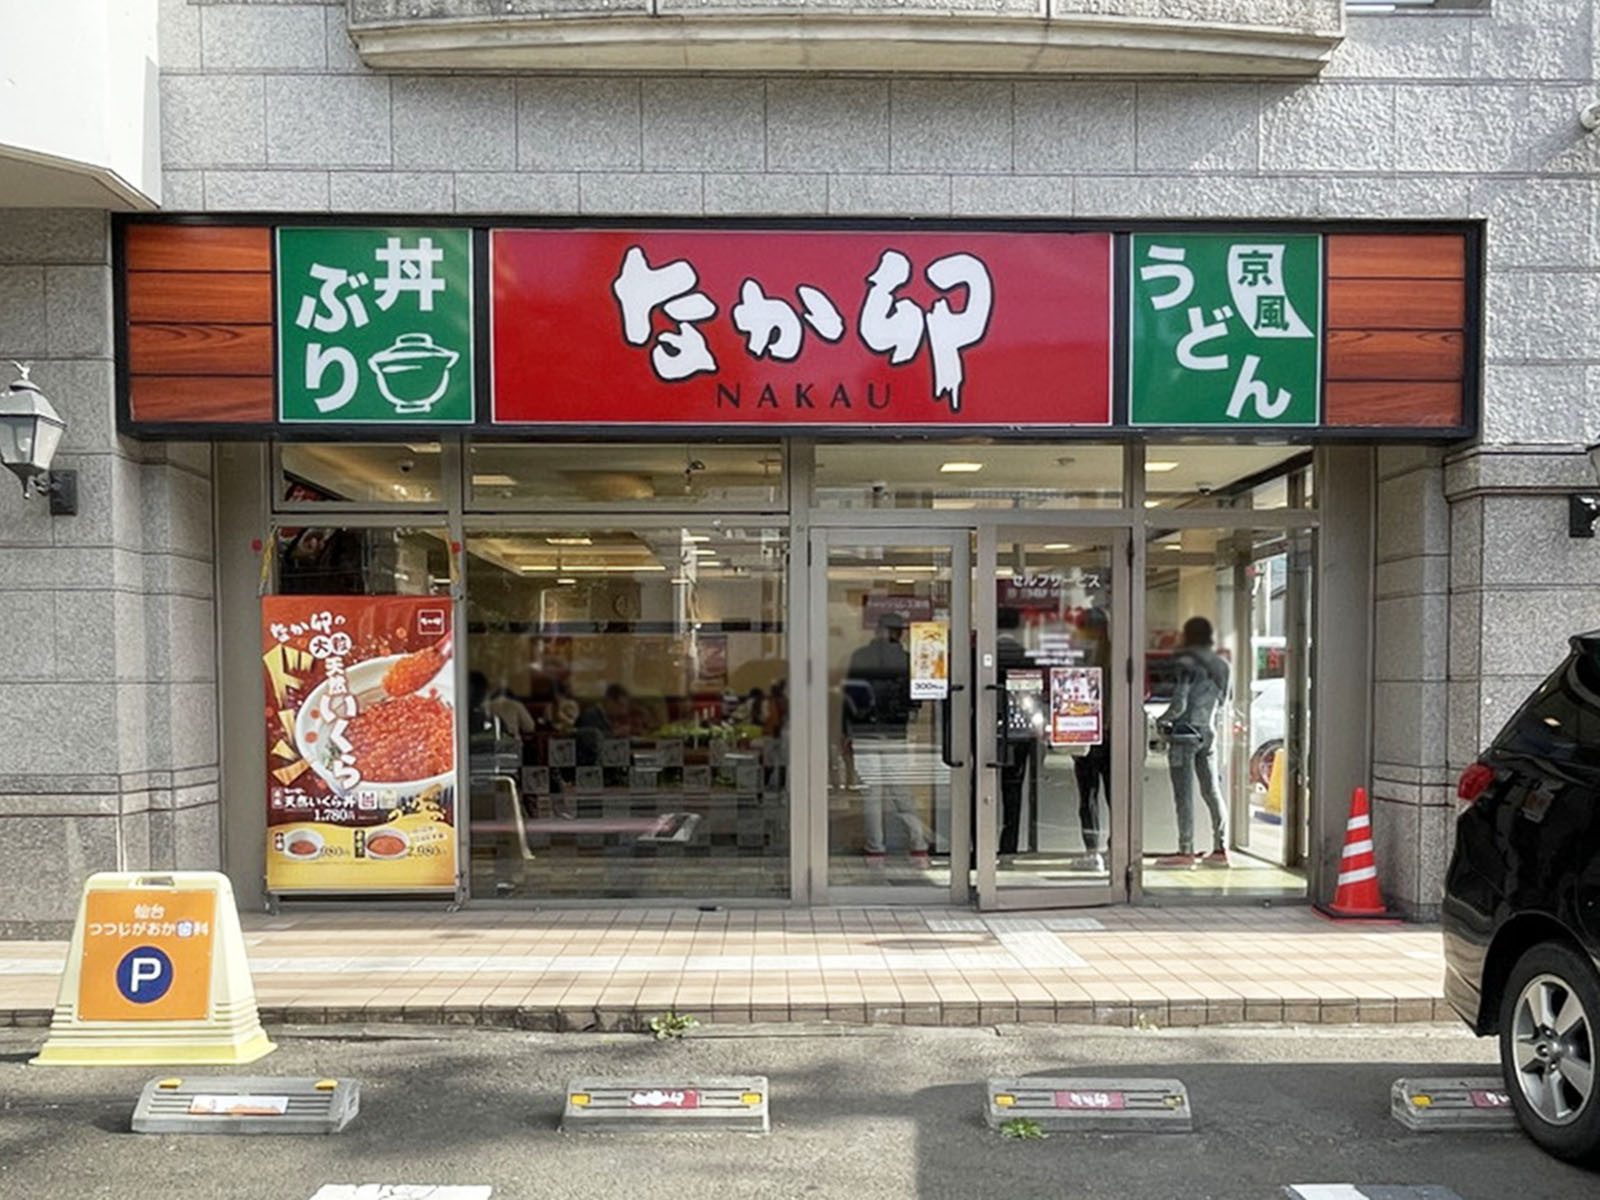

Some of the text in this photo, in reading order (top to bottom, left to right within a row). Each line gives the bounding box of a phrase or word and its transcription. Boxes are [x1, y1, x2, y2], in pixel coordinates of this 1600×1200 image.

[1236, 249, 1290, 332] 京風
[612, 245, 994, 414] なか卯
[1140, 244, 1292, 420] うどん
[716, 382, 892, 409] NAKAU
[1012, 573, 1101, 589] セルフサービス
[270, 610, 347, 644] なか卯の
[134, 904, 165, 920] 仙台
[130, 957, 162, 993] P
